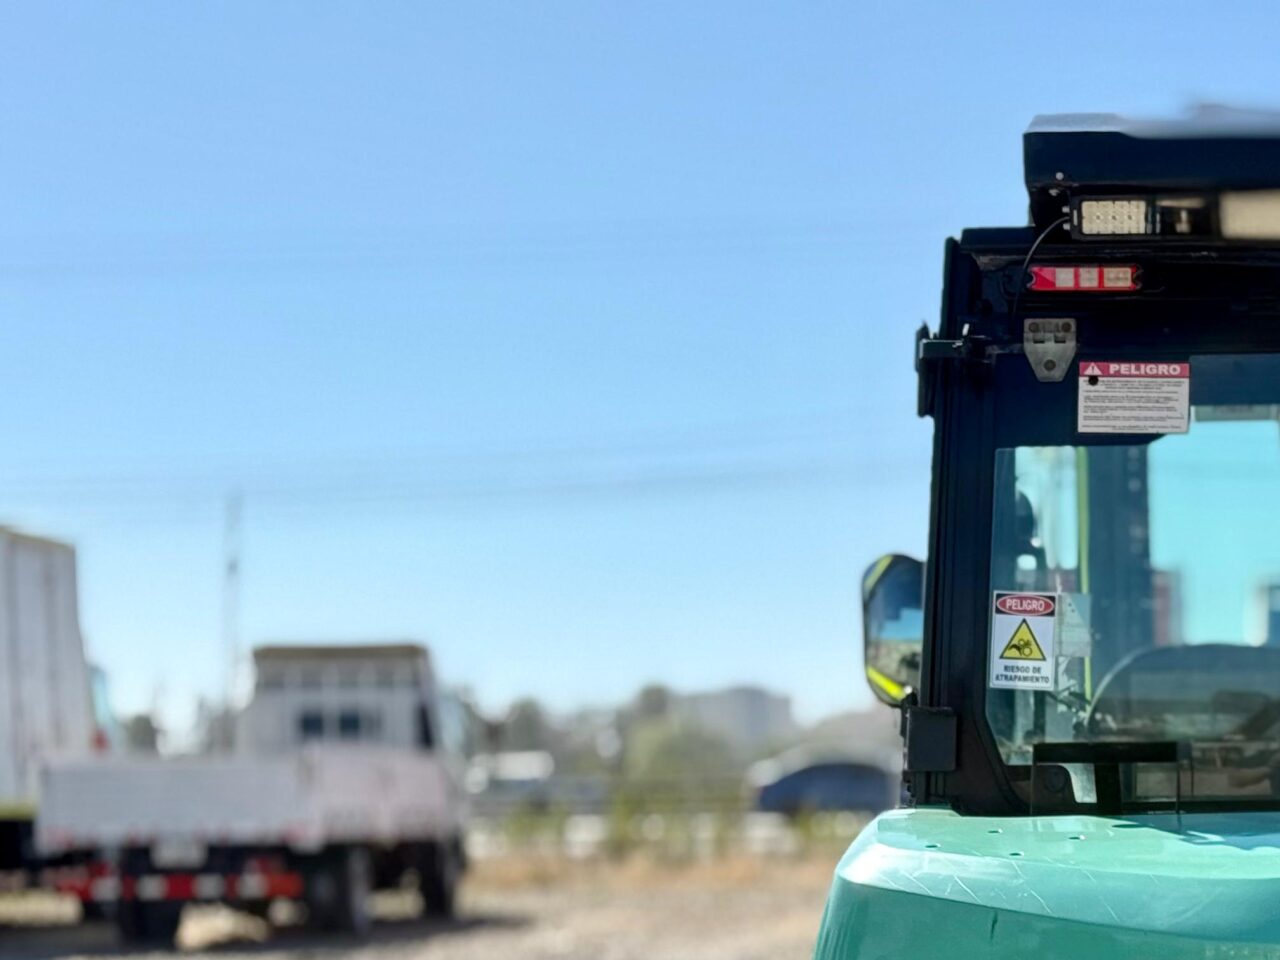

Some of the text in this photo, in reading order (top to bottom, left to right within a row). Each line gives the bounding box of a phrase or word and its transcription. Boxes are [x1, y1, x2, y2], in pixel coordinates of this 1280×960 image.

[1109, 363, 1181, 375] PELIGRO
[1006, 599, 1045, 611] PELIGRO
[1004, 665, 1042, 674] RIESGO DE
[995, 674, 1050, 684] ATRAPAMIENTO
